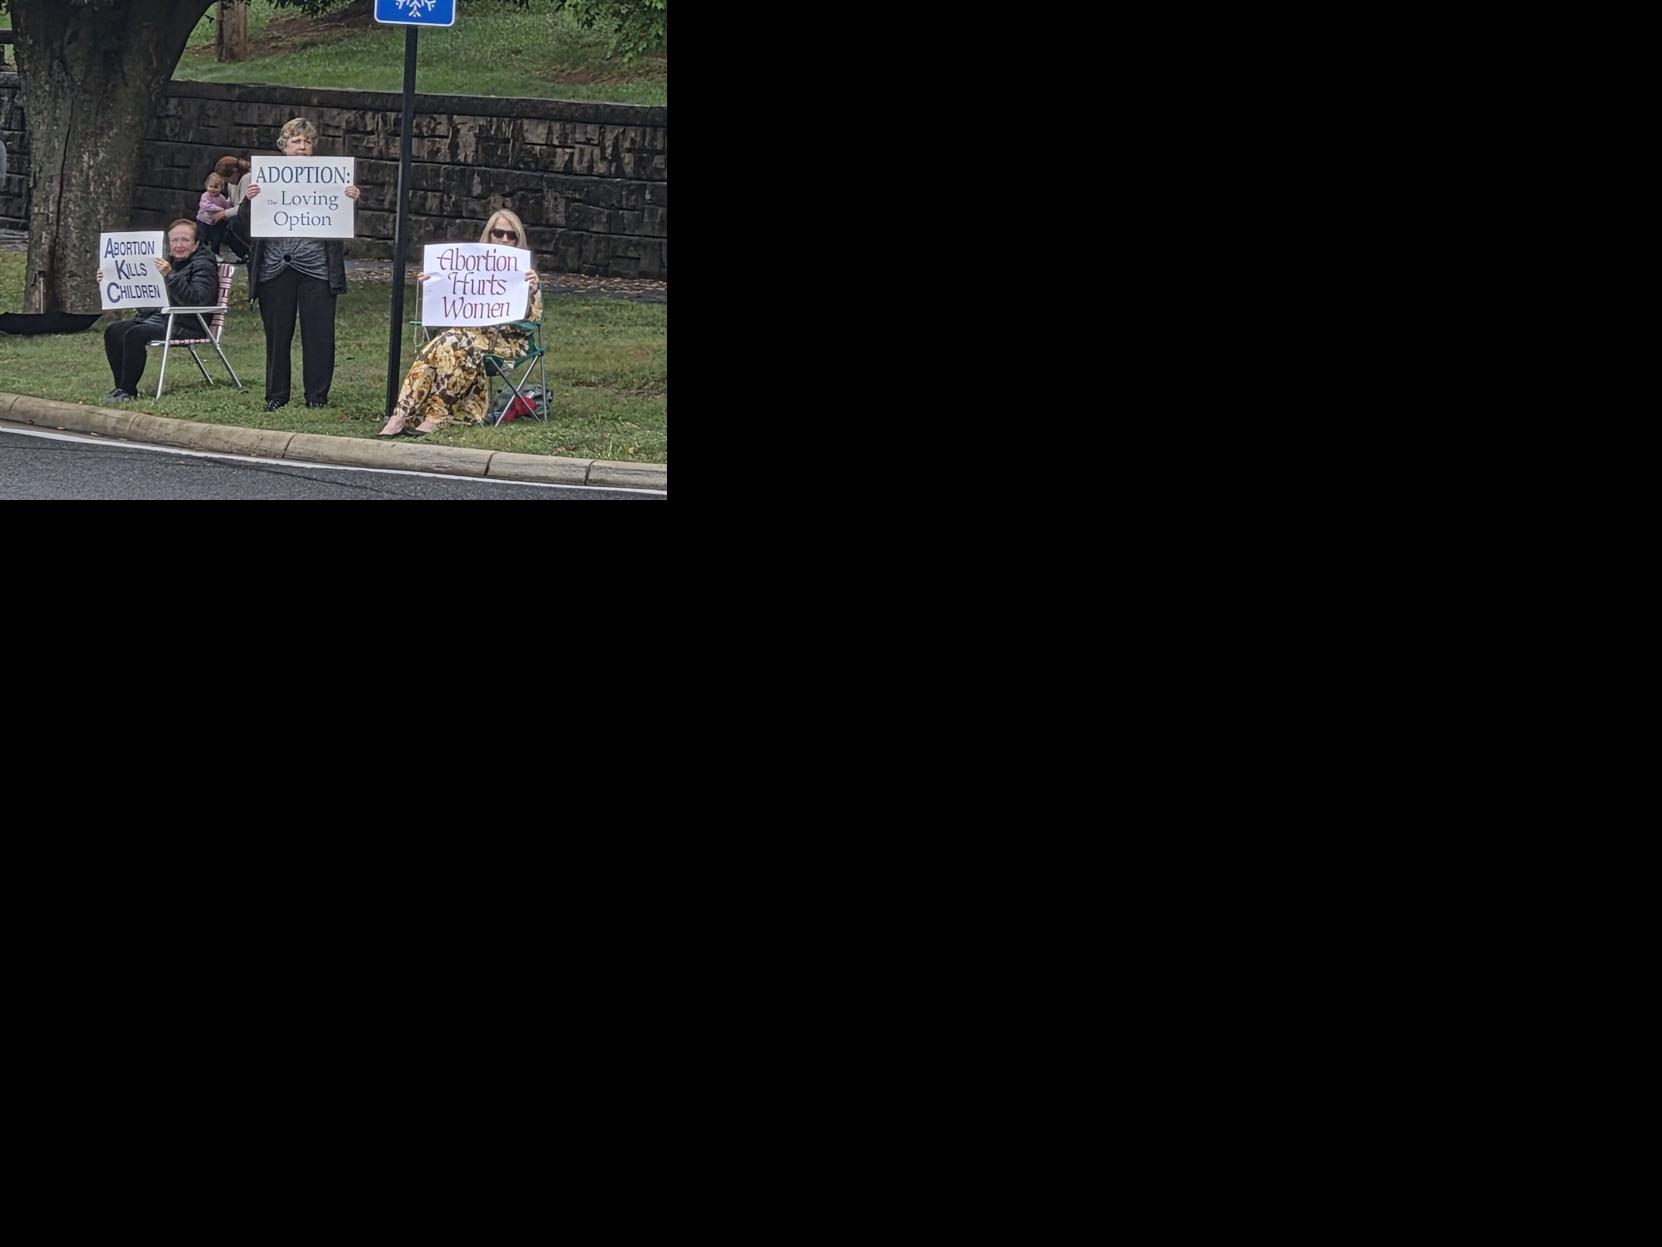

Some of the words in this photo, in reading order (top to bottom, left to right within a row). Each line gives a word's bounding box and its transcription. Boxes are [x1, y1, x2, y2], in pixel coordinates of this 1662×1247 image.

[256, 166, 350, 184] ADOPTION:
[281, 190, 339, 211] Loving
[273, 211, 332, 231] Option
[104, 238, 155, 258] ABORTION
[115, 260, 148, 280] KILLS
[436, 248, 518, 272] Abortion
[107, 282, 161, 303] CHILDREN
[448, 272, 508, 295] Hurts
[442, 296, 510, 320] Women
